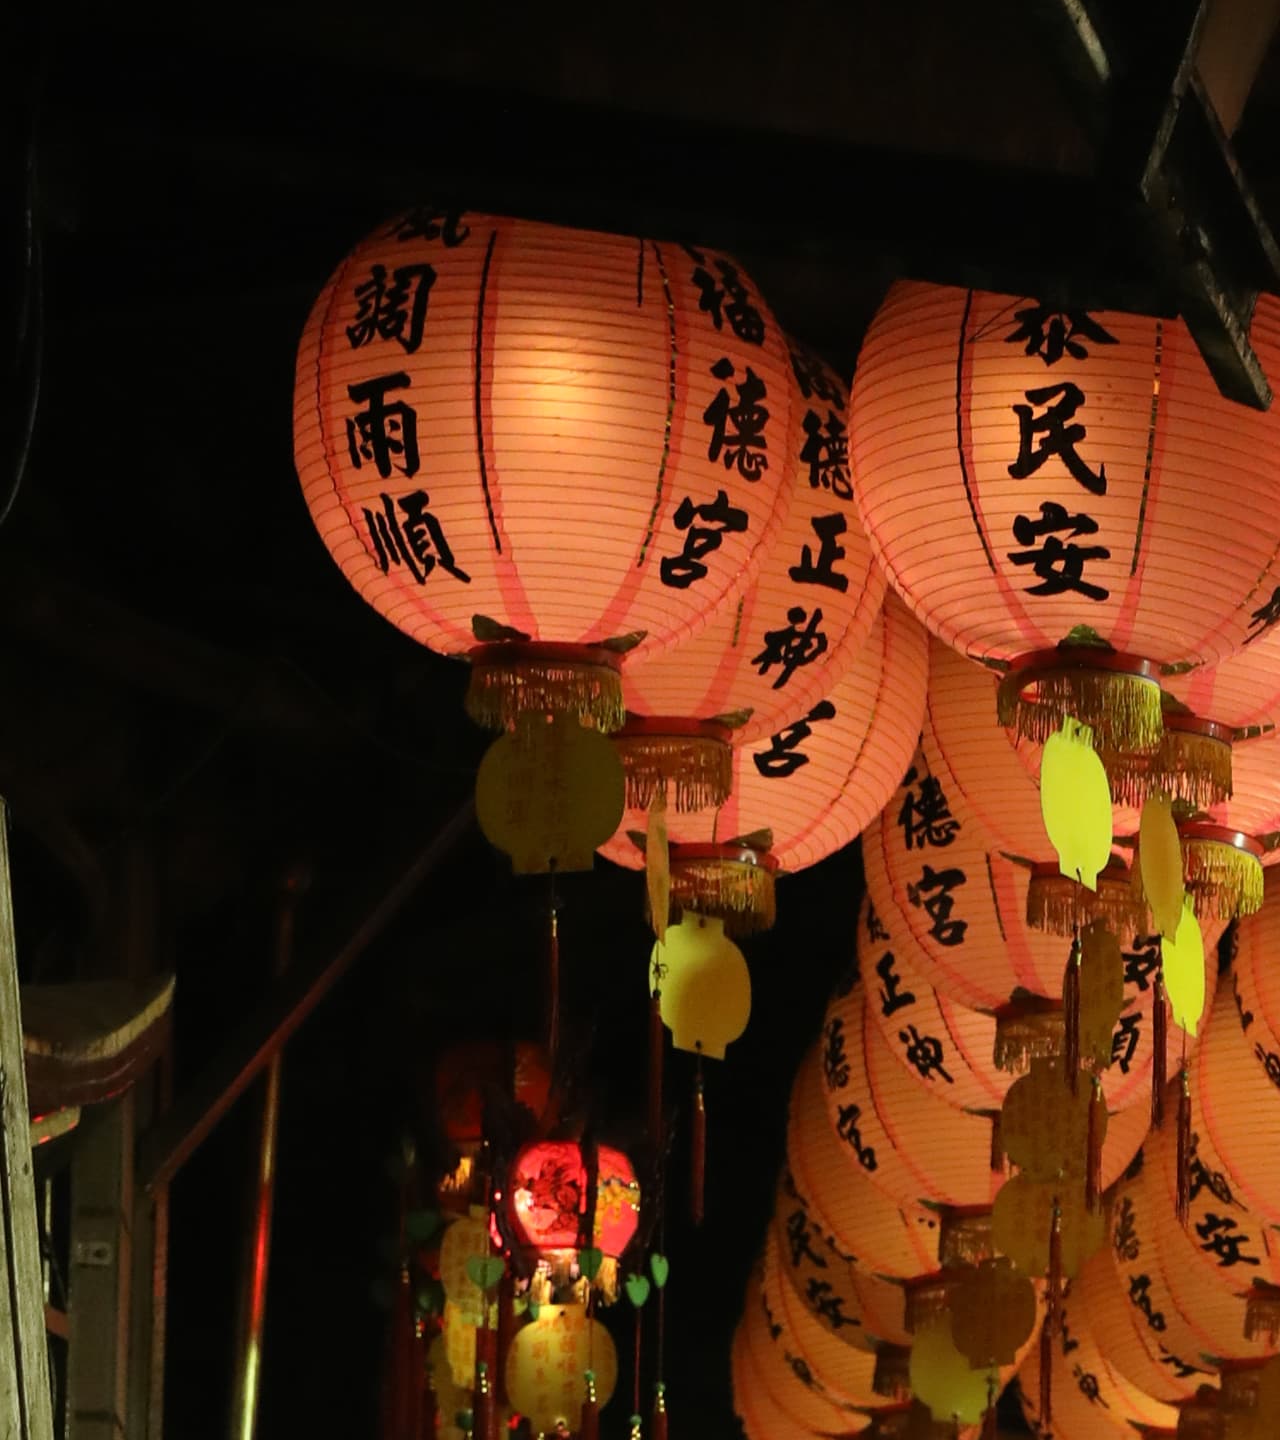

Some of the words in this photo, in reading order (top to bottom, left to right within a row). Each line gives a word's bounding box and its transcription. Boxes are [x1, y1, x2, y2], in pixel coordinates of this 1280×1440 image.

[660, 244, 768, 590] 福德宮
[897, 766, 968, 946] 德宮
